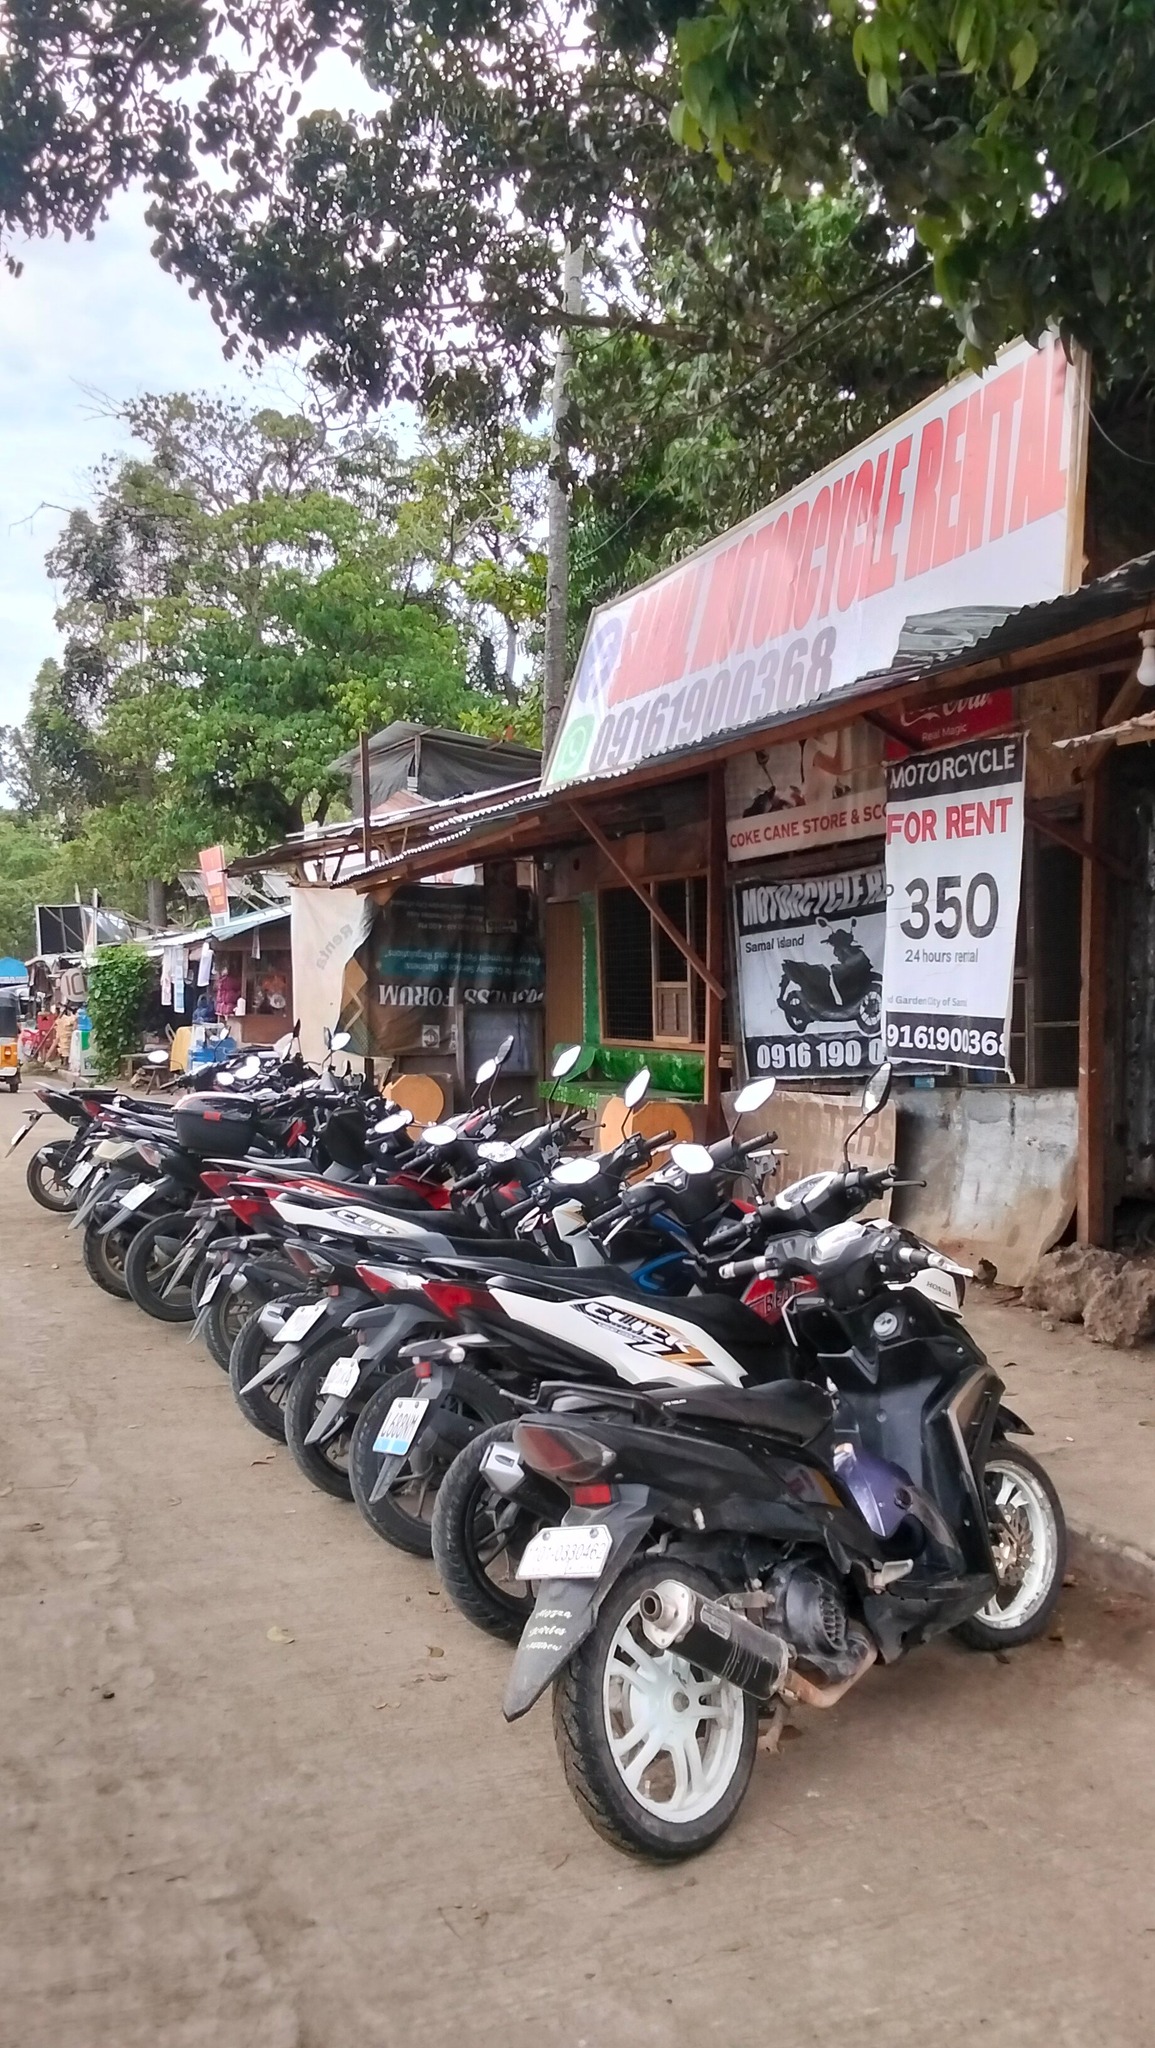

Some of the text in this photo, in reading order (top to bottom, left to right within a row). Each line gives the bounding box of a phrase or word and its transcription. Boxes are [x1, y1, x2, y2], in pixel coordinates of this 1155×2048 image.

[689, 433, 913, 676] MOTORCYCLE
[904, 338, 1068, 581] RENTAL
[589, 626, 837, 773] 09161900368
[922, 723, 968, 742] Real Magic
[889, 744, 1016, 789] MOTORCYCLE
[730, 828, 761, 848] COKE
[763, 821, 800, 841] CANE
[802, 811, 847, 834] STORE
[851, 808, 860, 825] &
[886, 796, 1014, 846] FOR RENT
[742, 872, 865, 927] MOTORCYCLE
[900, 872, 999, 940] 350
[745, 937, 775, 954] Samal
[905, 949, 921, 963] 24
[922, 949, 952, 963] hours
[378, 984, 456, 1007] FORUM
[942, 997, 950, 1007] of
[756, 1041, 813, 1069] 0916
[815, 1039, 862, 1068] 190
[926, 1281, 952, 1298] HONDA
